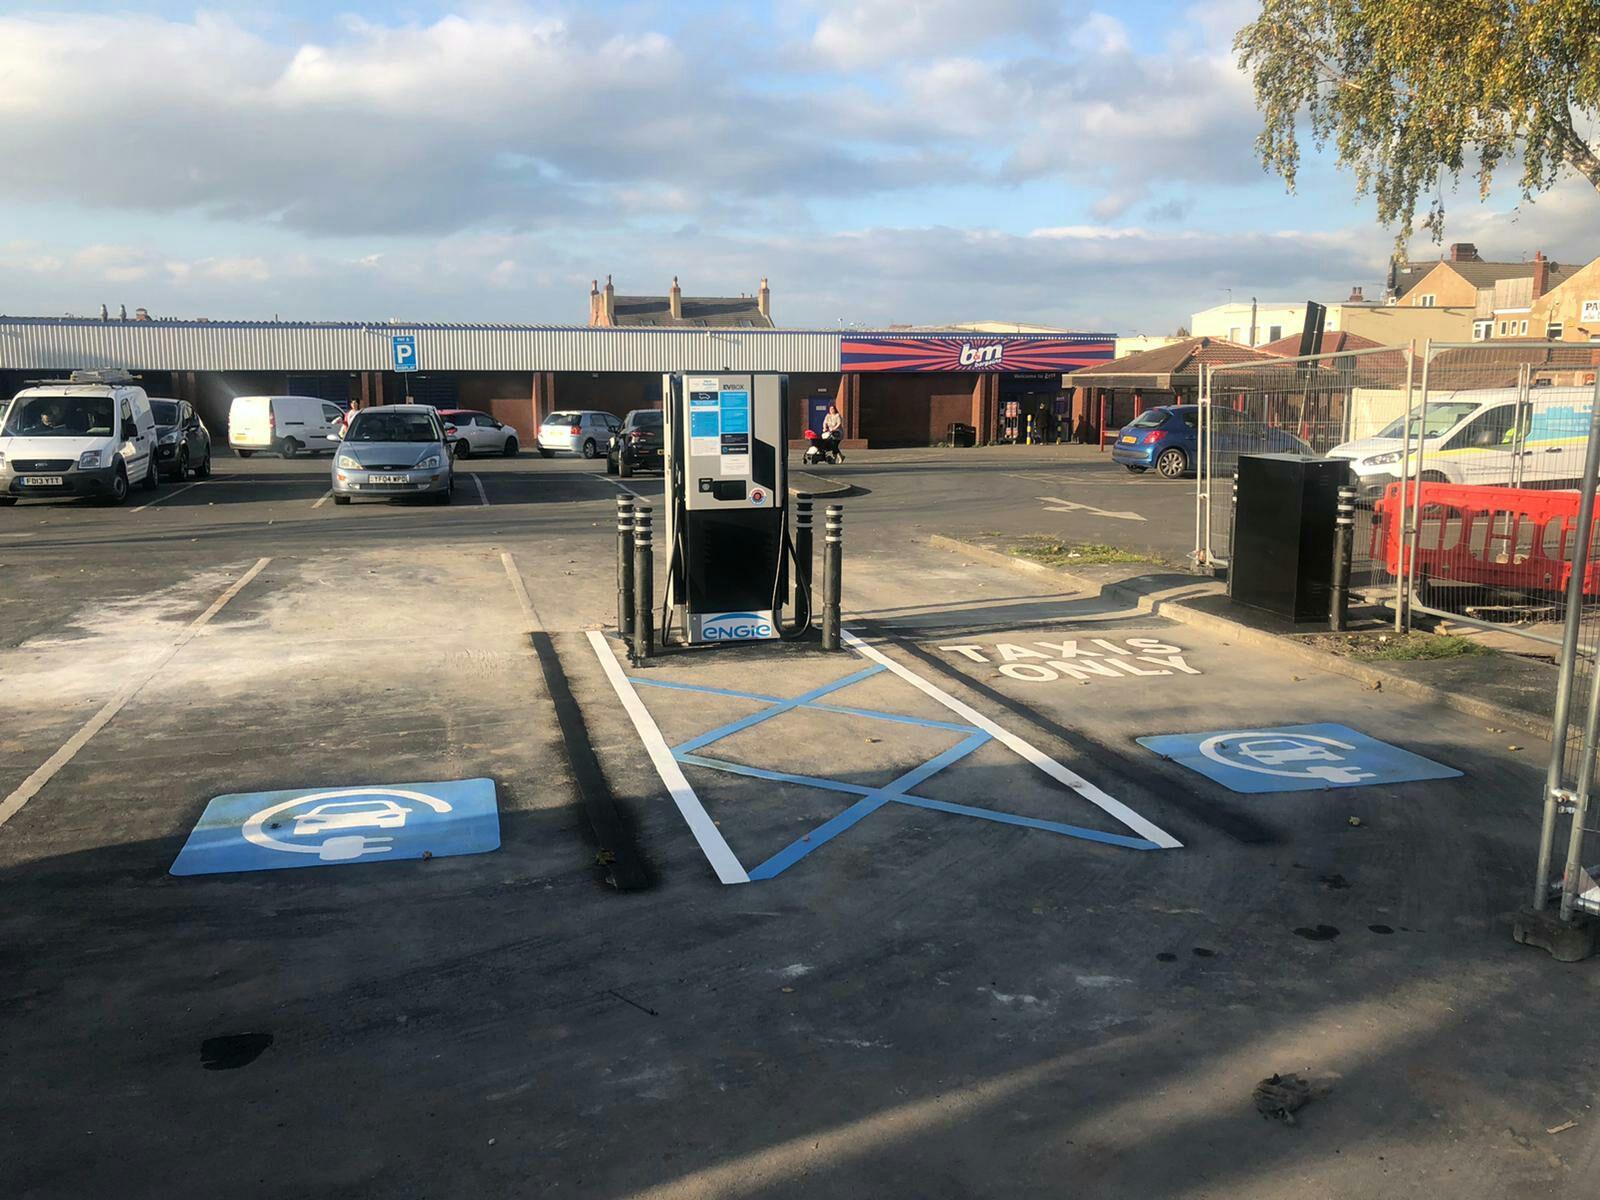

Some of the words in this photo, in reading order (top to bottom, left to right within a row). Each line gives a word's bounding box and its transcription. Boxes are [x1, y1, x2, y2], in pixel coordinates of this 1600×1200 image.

[397, 344, 412, 364] P
[938, 638, 1182, 663] TAXIS
[998, 655, 1202, 682] ONLY
